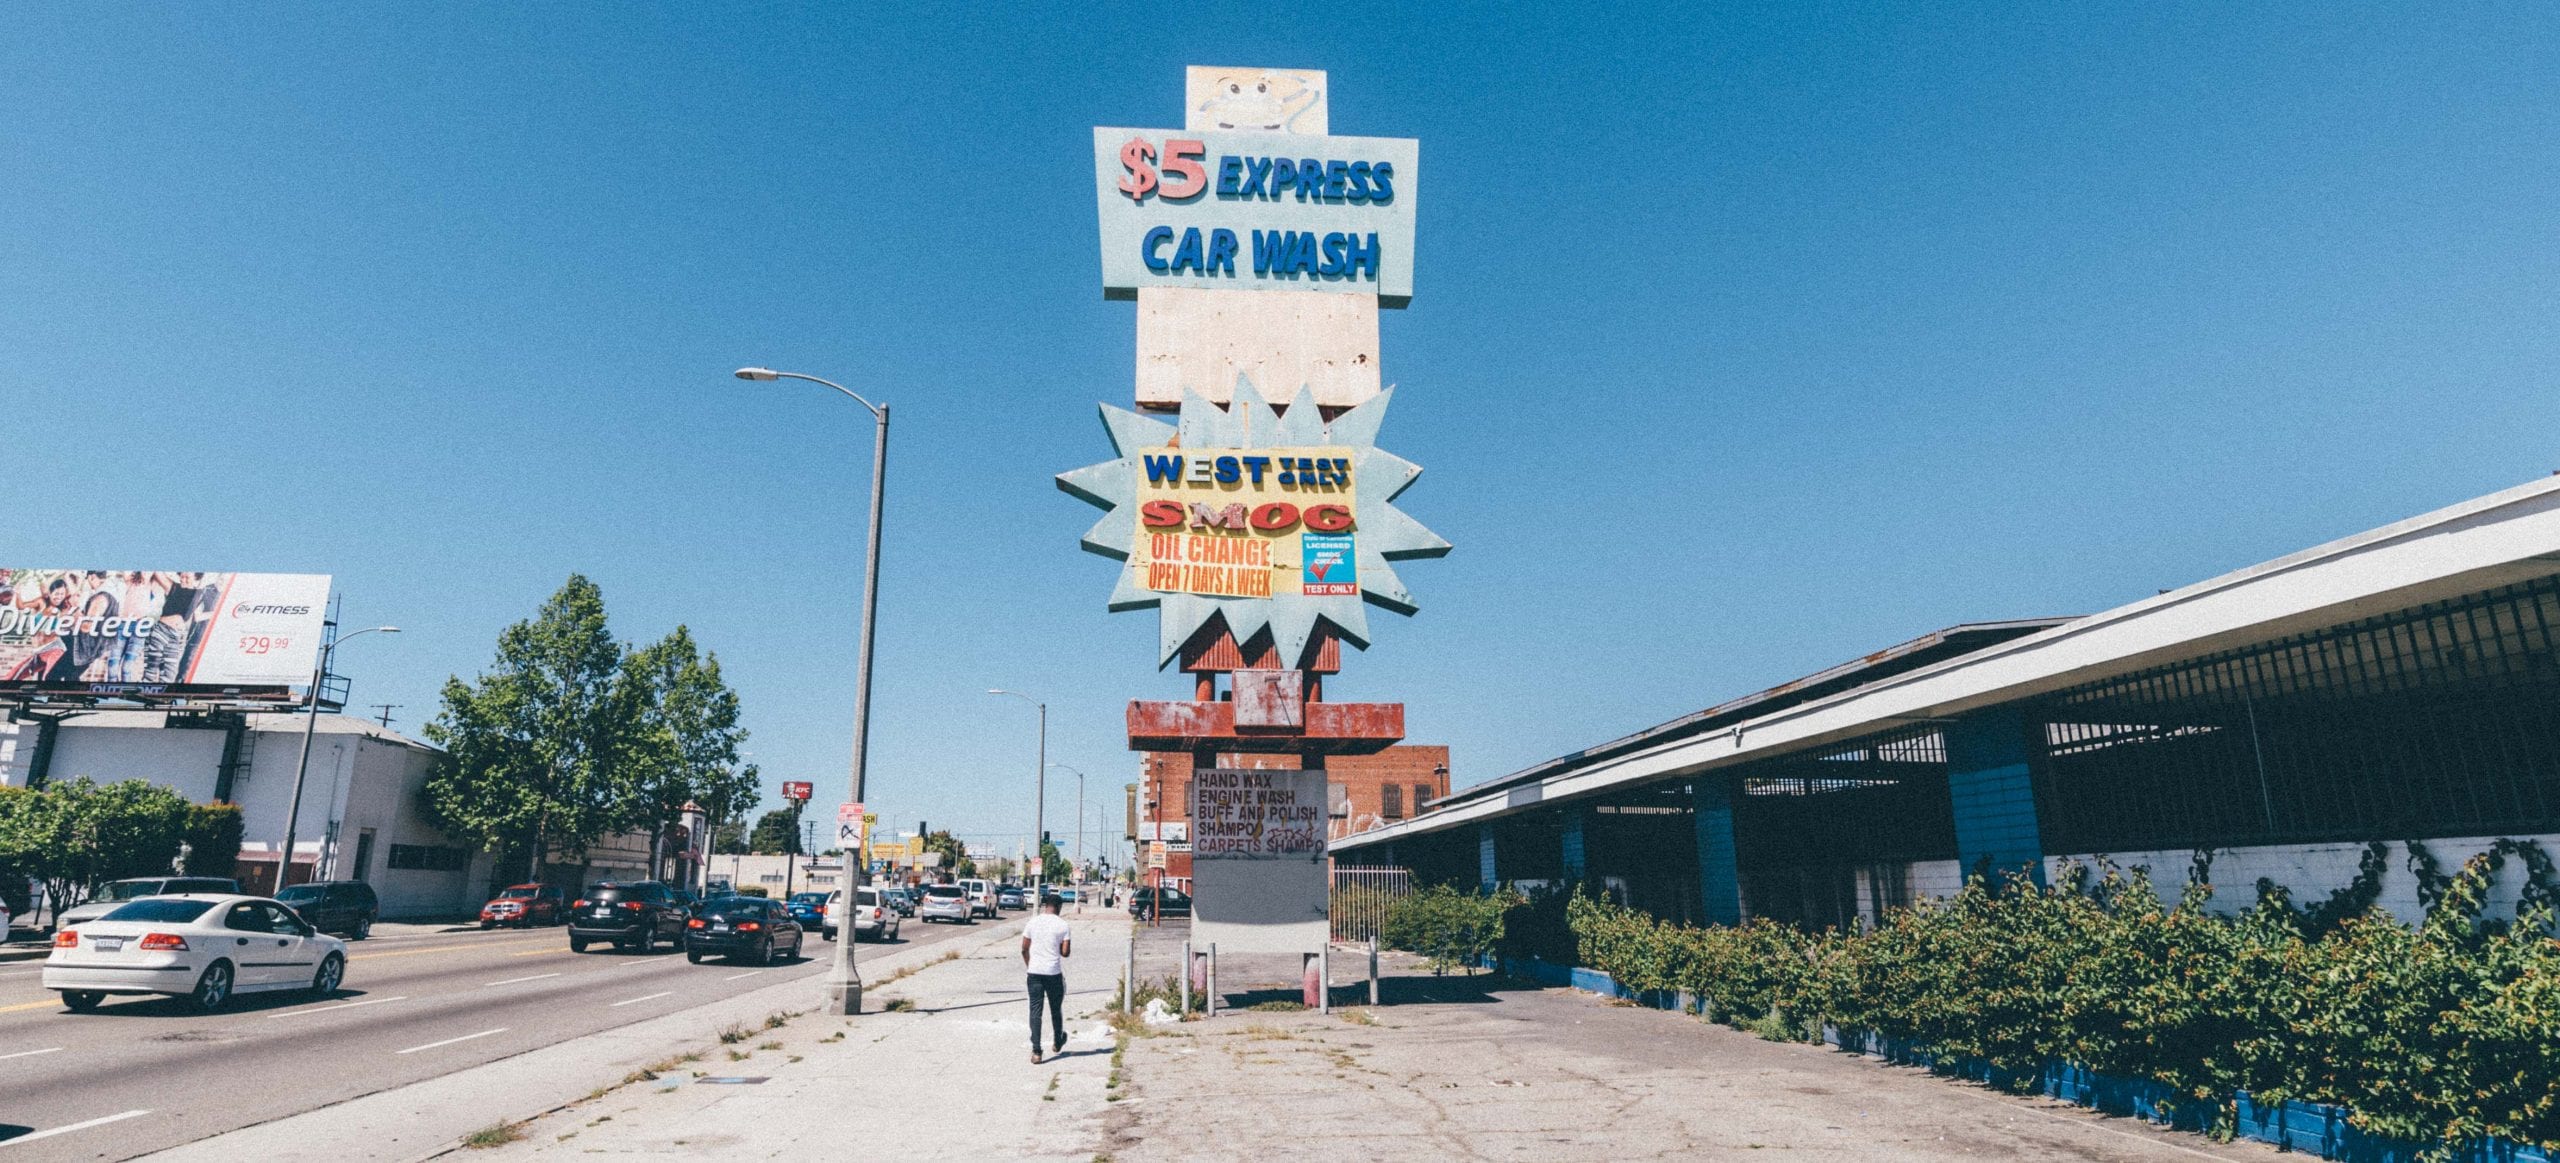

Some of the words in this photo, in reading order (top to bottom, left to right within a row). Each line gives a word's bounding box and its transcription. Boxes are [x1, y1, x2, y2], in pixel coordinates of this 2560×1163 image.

[1119, 136, 1207, 200] $5
[1216, 155, 1394, 201] EXPRESS
[1142, 225, 1238, 273] CAR
[1251, 229, 1381, 277] WASH
[1143, 454, 1271, 484] WEST
[1279, 457, 1349, 471] TEST
[1278, 471, 1348, 486] ONLY
[1141, 500, 1355, 531] SMOG
[1151, 532, 1183, 561] OIL
[1188, 534, 1271, 567] CHANGE
[1148, 561, 1181, 590] OPEN
[1183, 564, 1190, 592] 7
[1192, 565, 1223, 594] DAYS
[1225, 567, 1234, 594] A
[1237, 568, 1271, 597] WEEK
[1304, 584, 1328, 594] TEST
[1329, 584, 1355, 594] ONLY
[252, 605, 311, 615] FITNESS
[0, 607, 154, 637] Diviértete
[1199, 773, 1238, 789] HAND
[1243, 774, 1272, 788] WAX
[1199, 789, 1252, 804] ENGINE
[1257, 790, 1295, 805] WASH
[1198, 805, 1233, 820] BUFF
[1238, 806, 1265, 820] AND
[1269, 807, 1318, 821] POLISH
[1198, 838, 1261, 853] CARPETS
